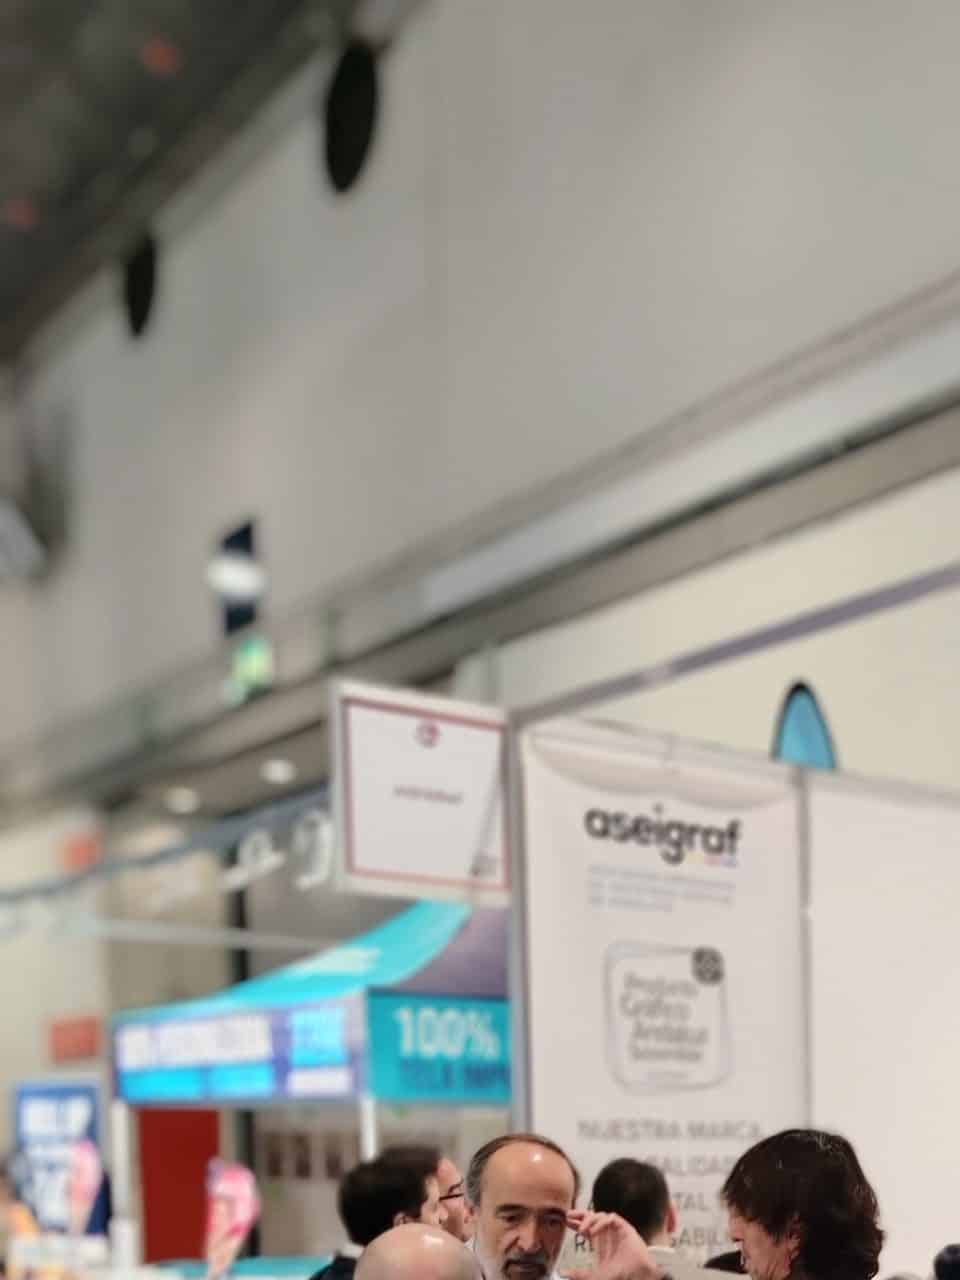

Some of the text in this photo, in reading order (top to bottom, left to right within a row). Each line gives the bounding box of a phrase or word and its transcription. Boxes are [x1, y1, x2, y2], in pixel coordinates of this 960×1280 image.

[584, 802, 741, 865] aseigraf
[394, 1006, 500, 1060] 100%
[577, 1119, 760, 1141] NUESTRA MARCA
